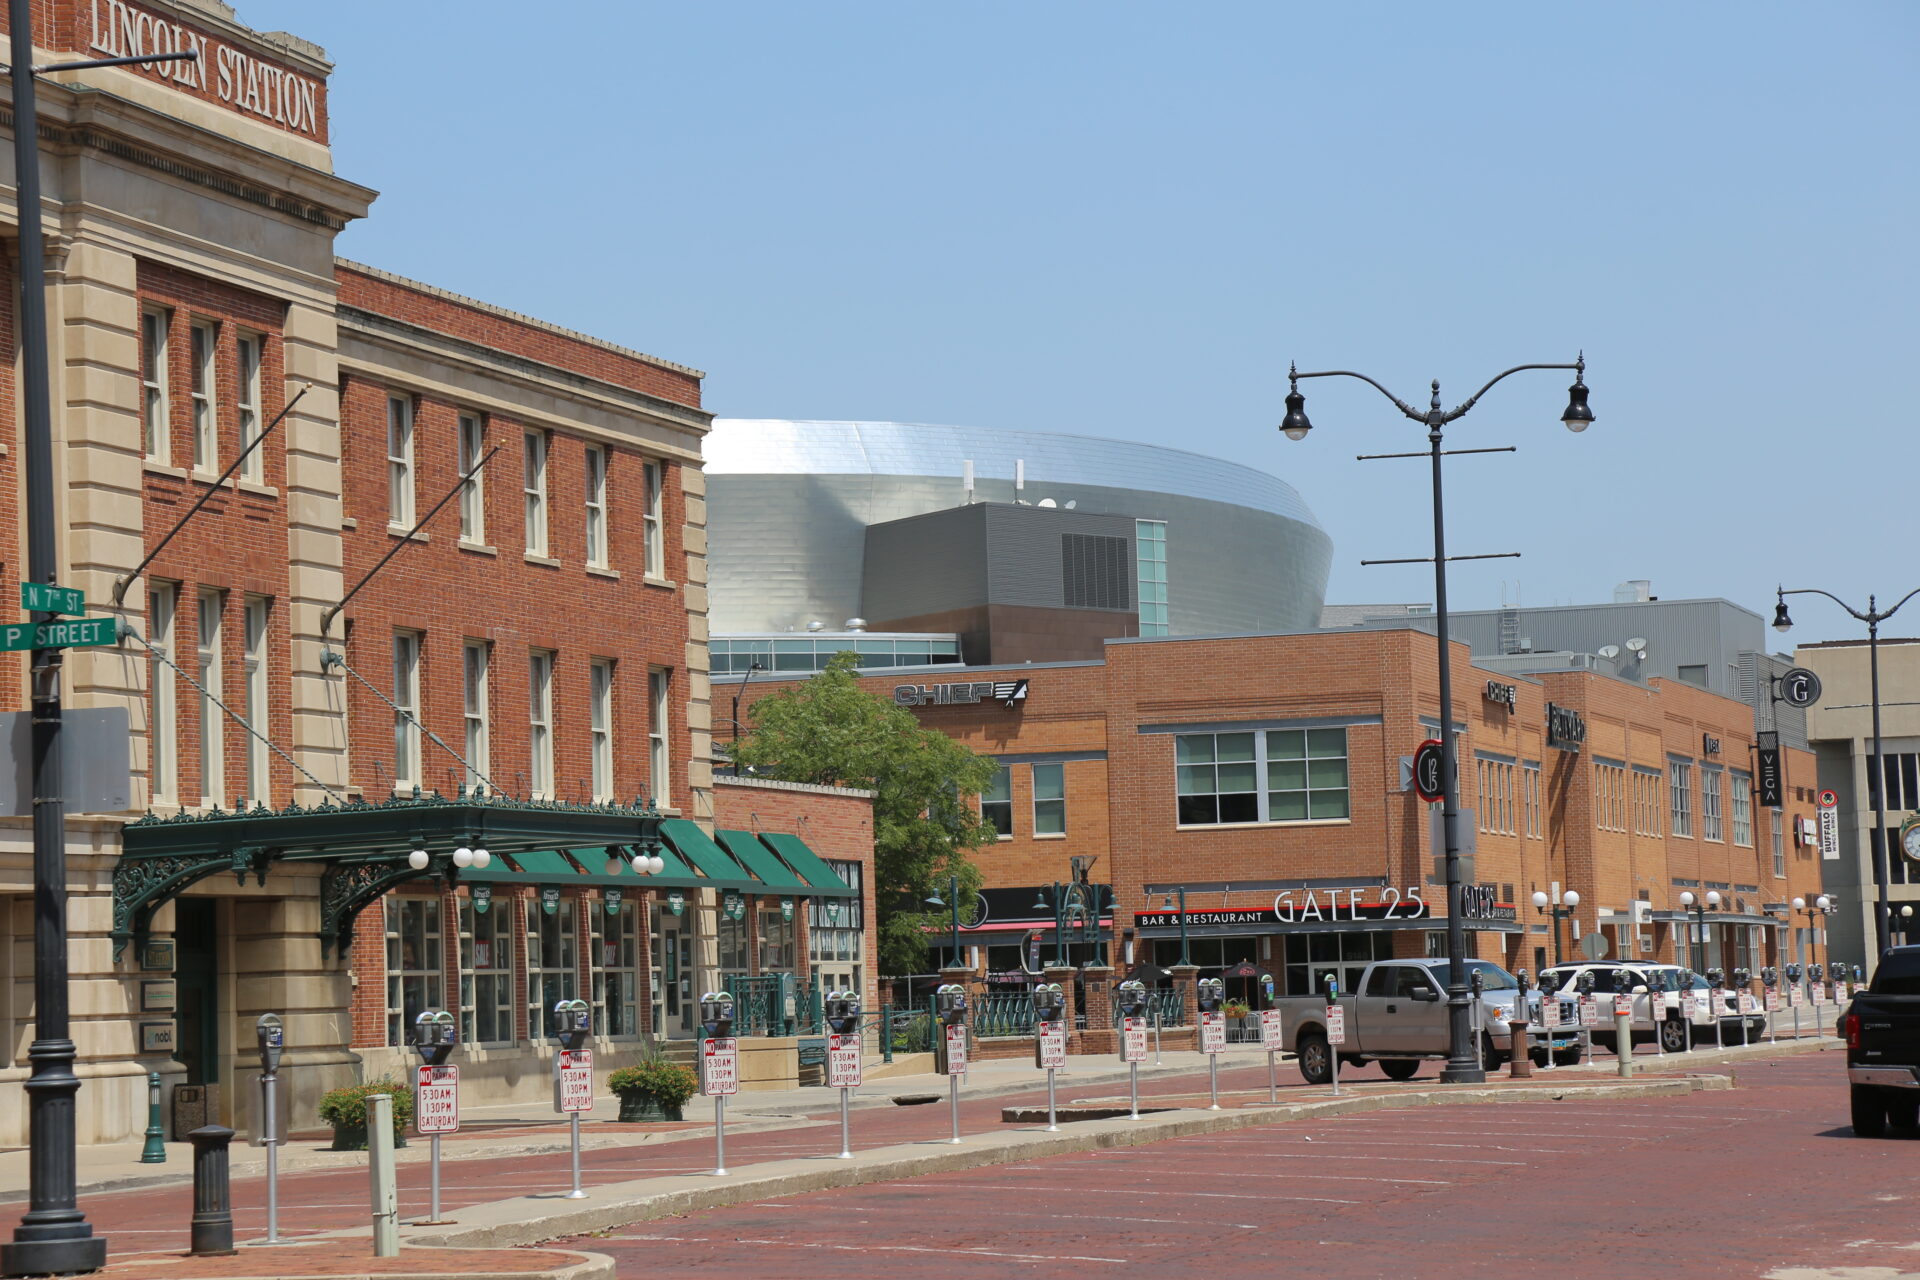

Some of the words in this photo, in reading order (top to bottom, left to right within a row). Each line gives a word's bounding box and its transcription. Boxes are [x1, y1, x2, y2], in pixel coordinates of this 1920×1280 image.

[90, 0, 207, 92] LINCOLN
[217, 44, 316, 135] STATION
[29, 587, 38, 606] N
[67, 592, 78, 612] ST
[6, 628, 20, 647] P
[36, 623, 101, 645] STREET
[894, 682, 993, 706] CHIEF
[1764, 754, 1776, 800] VEGA
[1823, 812, 1832, 853] BUFFALO
[1274, 888, 1367, 923] GATE
[1382, 887, 1424, 919] 25
[1142, 915, 1165, 926] BAR
[1171, 915, 1179, 925] &
[1186, 912, 1262, 924] RESTAURANT
[706, 1042, 715, 1053] NO
[831, 1038, 840, 1048] NO
[561, 1054, 570, 1066] NO
[420, 1070, 431, 1083] NO
[432, 1072, 456, 1080] PARKING
[832, 1074, 859, 1083] SATURDAY
[707, 1081, 736, 1091] SATURDAY
[563, 1096, 591, 1106] SATURDAY
[421, 1115, 456, 1127] SATURDAY
